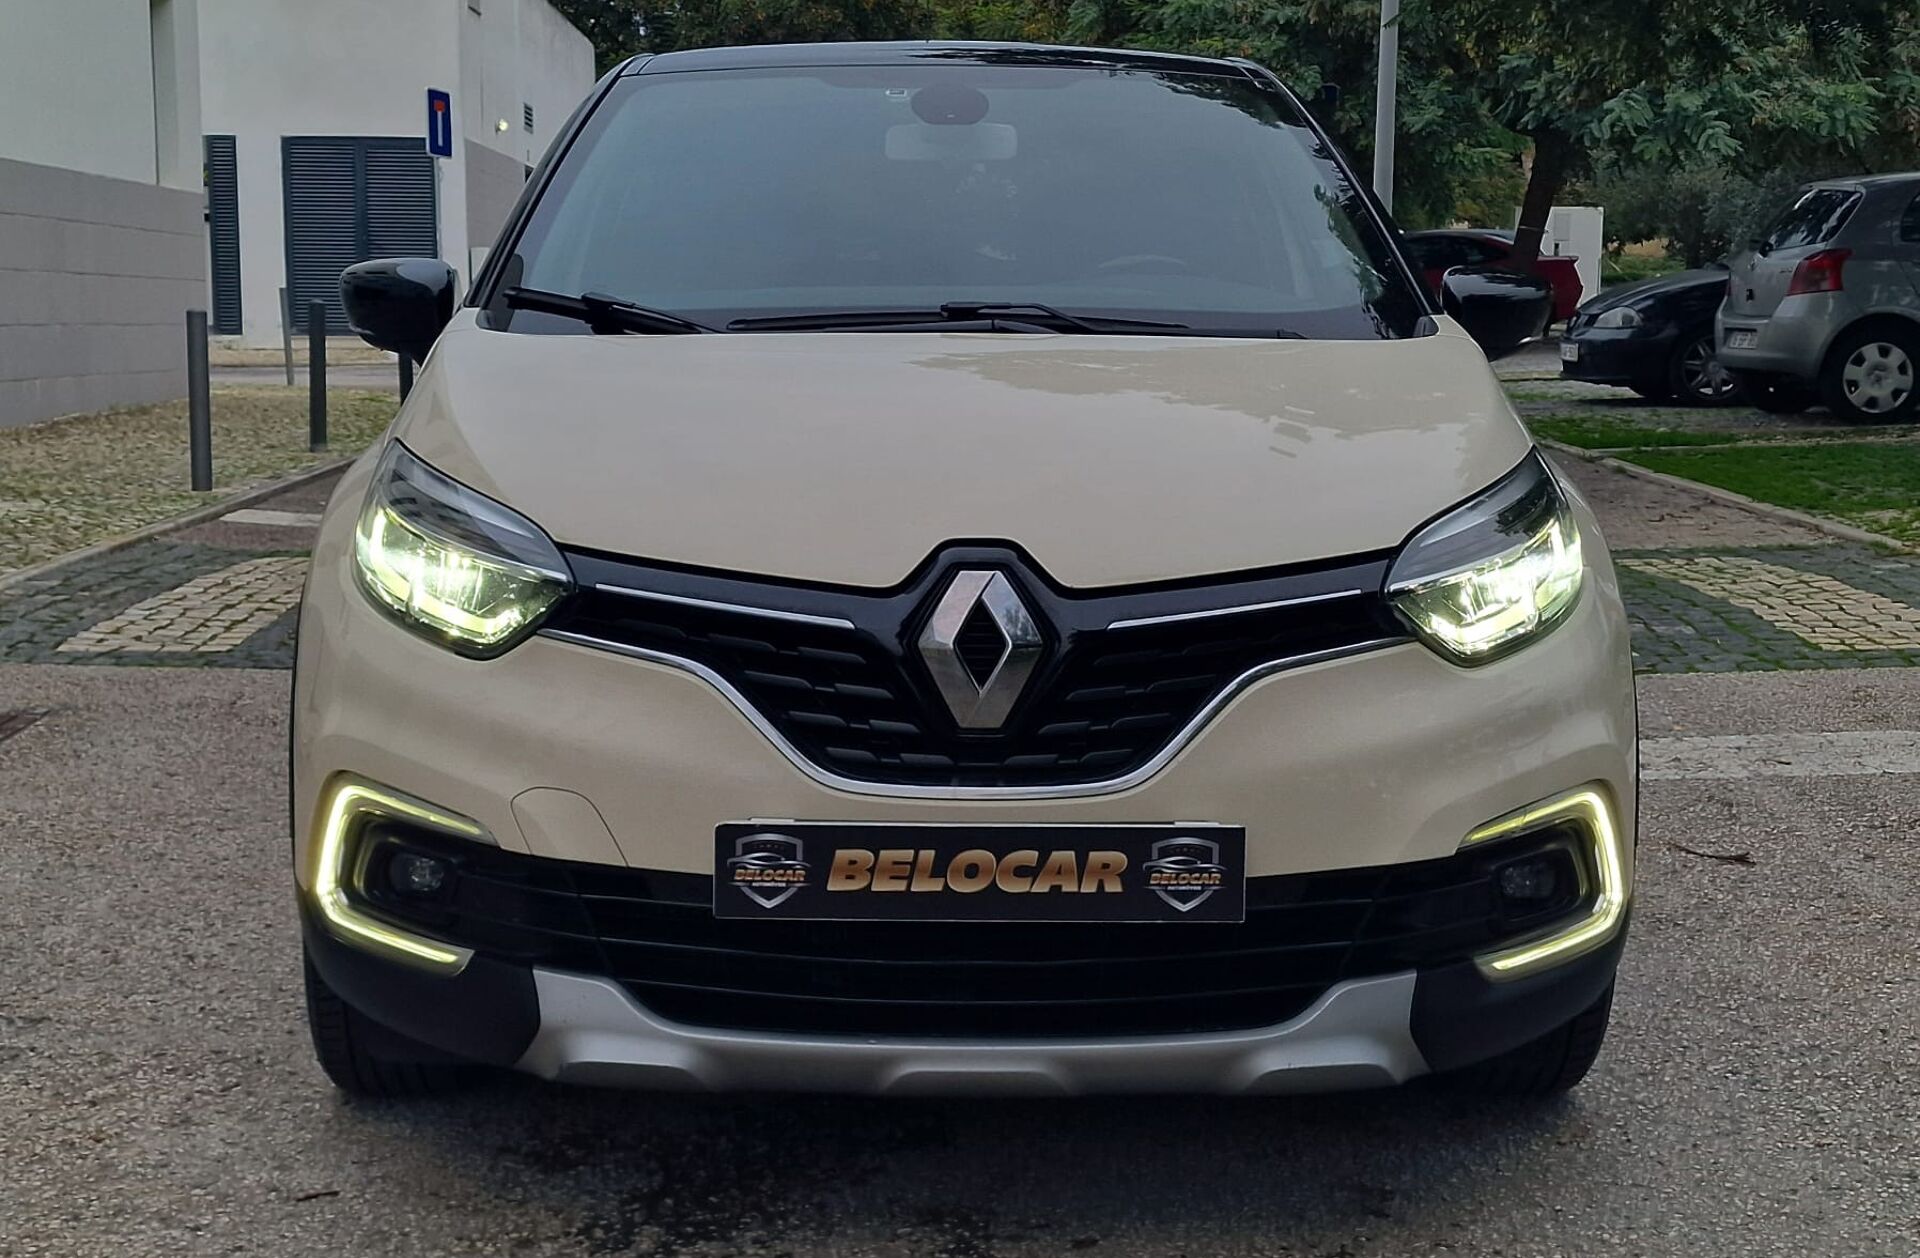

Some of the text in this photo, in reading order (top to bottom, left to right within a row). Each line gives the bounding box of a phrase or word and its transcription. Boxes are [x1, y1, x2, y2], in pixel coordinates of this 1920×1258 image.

[734, 869, 806, 881] BELOCAR
[826, 849, 1128, 893] BELOCAR
[1149, 873, 1222, 885] BELOCAR
